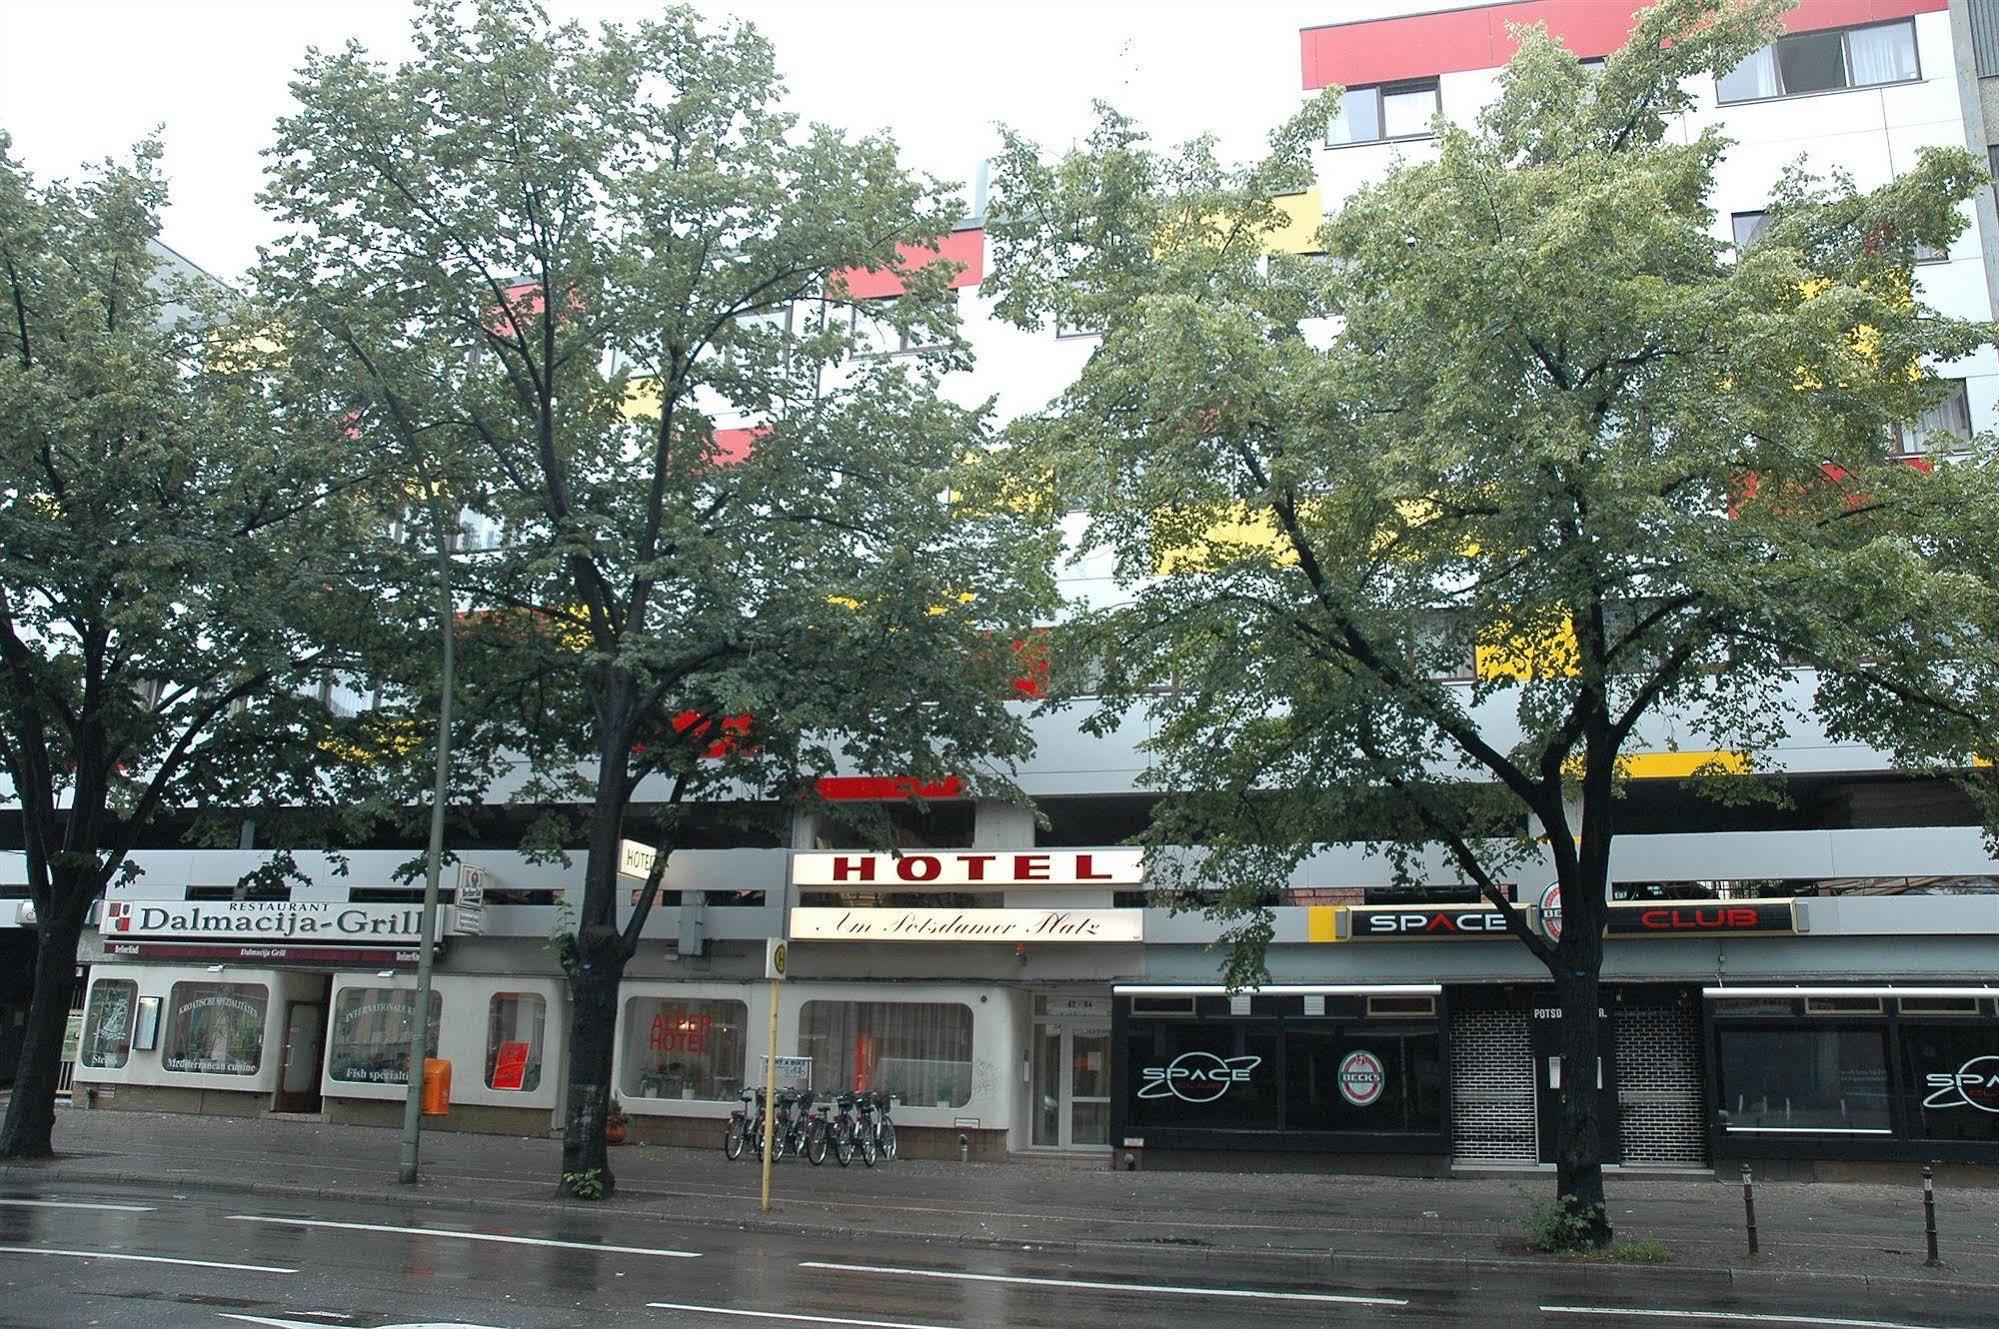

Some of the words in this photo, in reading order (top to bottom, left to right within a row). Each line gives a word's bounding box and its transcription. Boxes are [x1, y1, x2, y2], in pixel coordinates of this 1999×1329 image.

[833, 854, 1112, 881] HOTEL
[229, 902, 328, 912] RESTAURANT
[140, 908, 422, 936] Dalmacija-Grill
[884, 912, 1016, 935] Potsdamer
[1026, 911, 1100, 935] Platz
[1370, 912, 1507, 931] SPACE
[1641, 909, 1758, 928] CLUB
[1534, 1008, 1562, 1018] POTSD
[346, 1068, 367, 1078] Fish
[369, 1069, 409, 1081] specialti
[1143, 1068, 1250, 1081] SPACE
